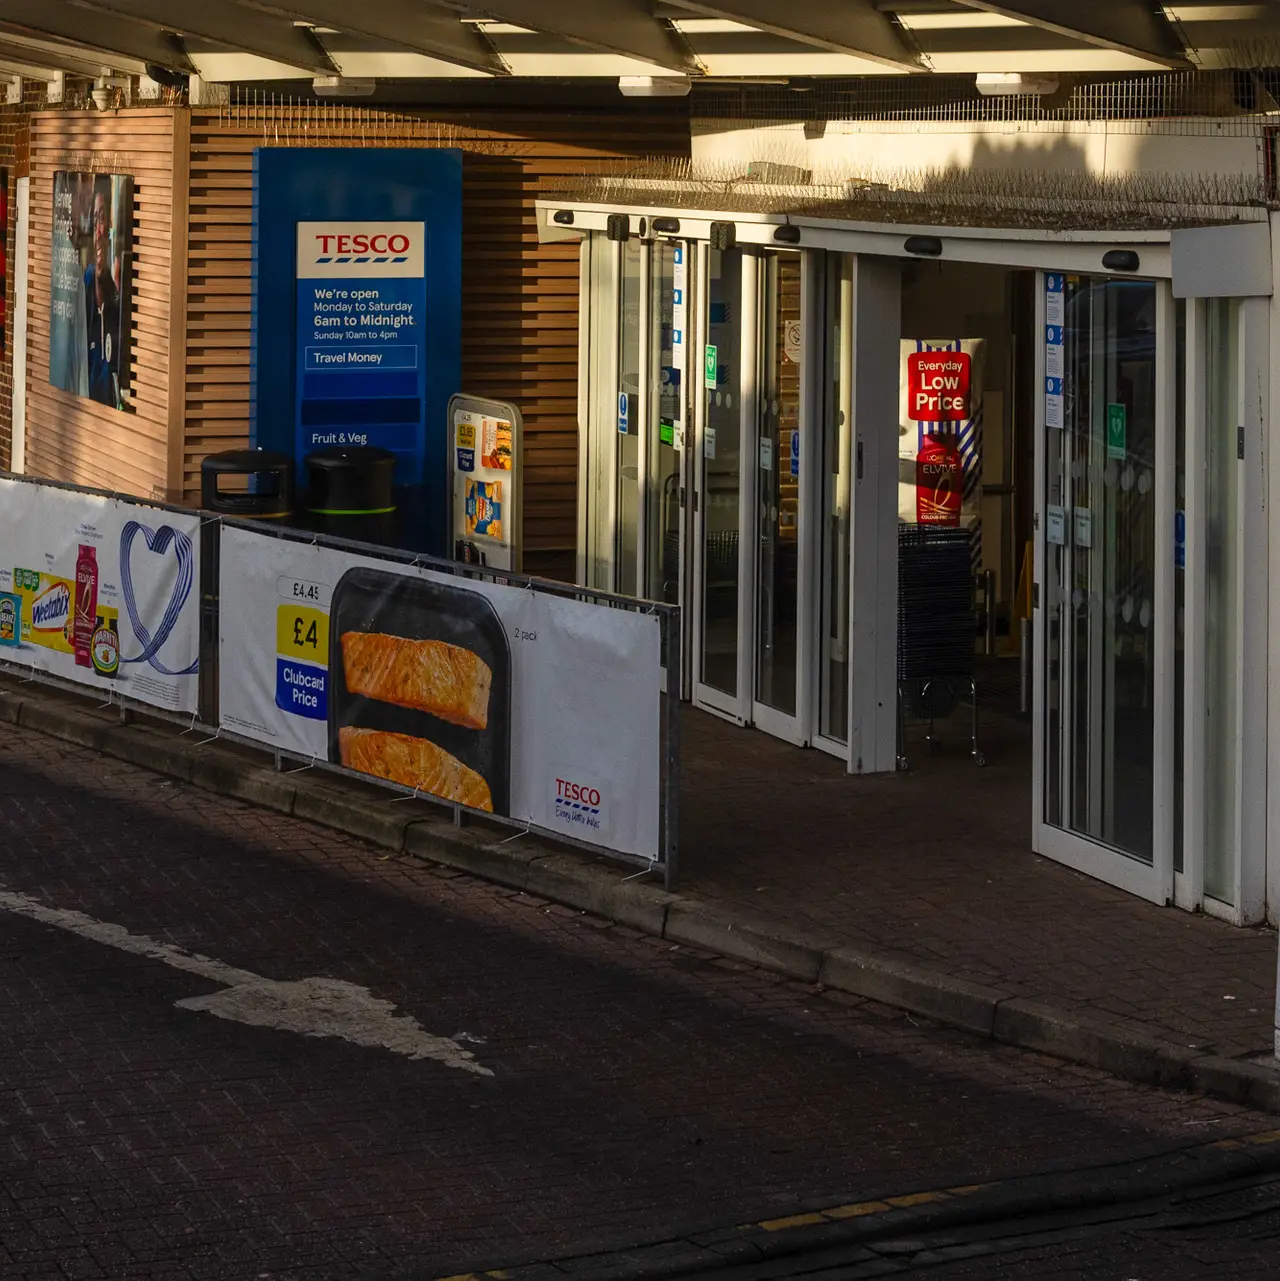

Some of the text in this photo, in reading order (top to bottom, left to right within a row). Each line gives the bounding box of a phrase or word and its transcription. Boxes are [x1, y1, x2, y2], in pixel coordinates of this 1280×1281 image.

[315, 234, 410, 254] TESCO
[314, 289, 379, 300] We're open
[313, 301, 413, 313] Monday to Saturday
[314, 315, 340, 326] 6am
[343, 316, 357, 326] to
[314, 331, 398, 341] Sunday 10am to 4pm
[314, 352, 383, 365] Travel Money
[918, 361, 963, 372] Everyday
[921, 373, 960, 390] Low
[915, 393, 965, 411] Price
[312, 432, 367, 445] Fruit & Veg
[923, 464, 957, 474] ELVIVE
[78, 572, 95, 585] ELVIVE
[293, 582, 319, 600] £4.45
[32, 592, 71, 624] Weetabix
[293, 617, 318, 649] £4
[514, 627, 538, 641] 2 pack
[283, 668, 325, 692] Clubcard
[292, 688, 318, 708] Price
[556, 778, 601, 806] TESCO
